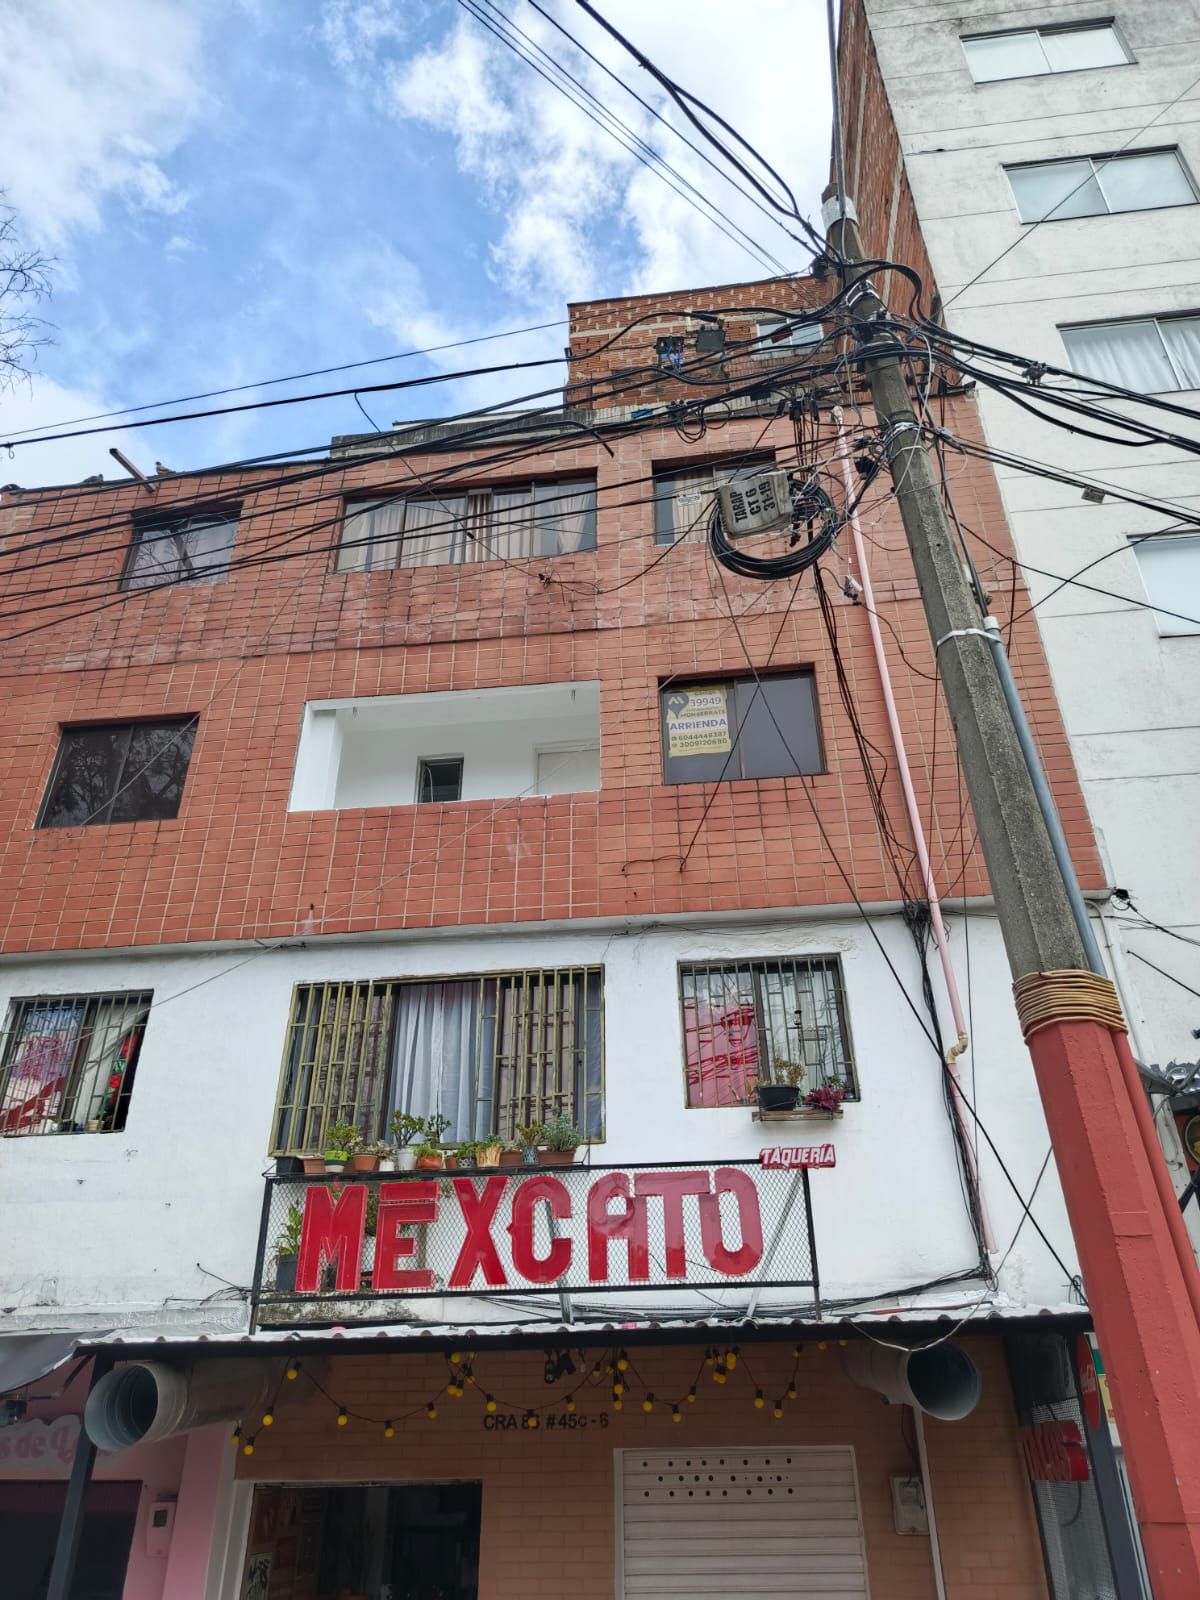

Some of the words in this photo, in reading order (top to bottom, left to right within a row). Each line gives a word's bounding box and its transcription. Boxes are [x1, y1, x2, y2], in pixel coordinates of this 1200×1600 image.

[745, 487, 757, 498] 6
[758, 481, 776, 512] 31-19
[729, 491, 748, 523] TARAP
[747, 499, 761, 515] CT
[690, 696, 722, 708] 39949
[669, 718, 727, 731] ARRIENDA
[483, 1414, 518, 1430] CRA
